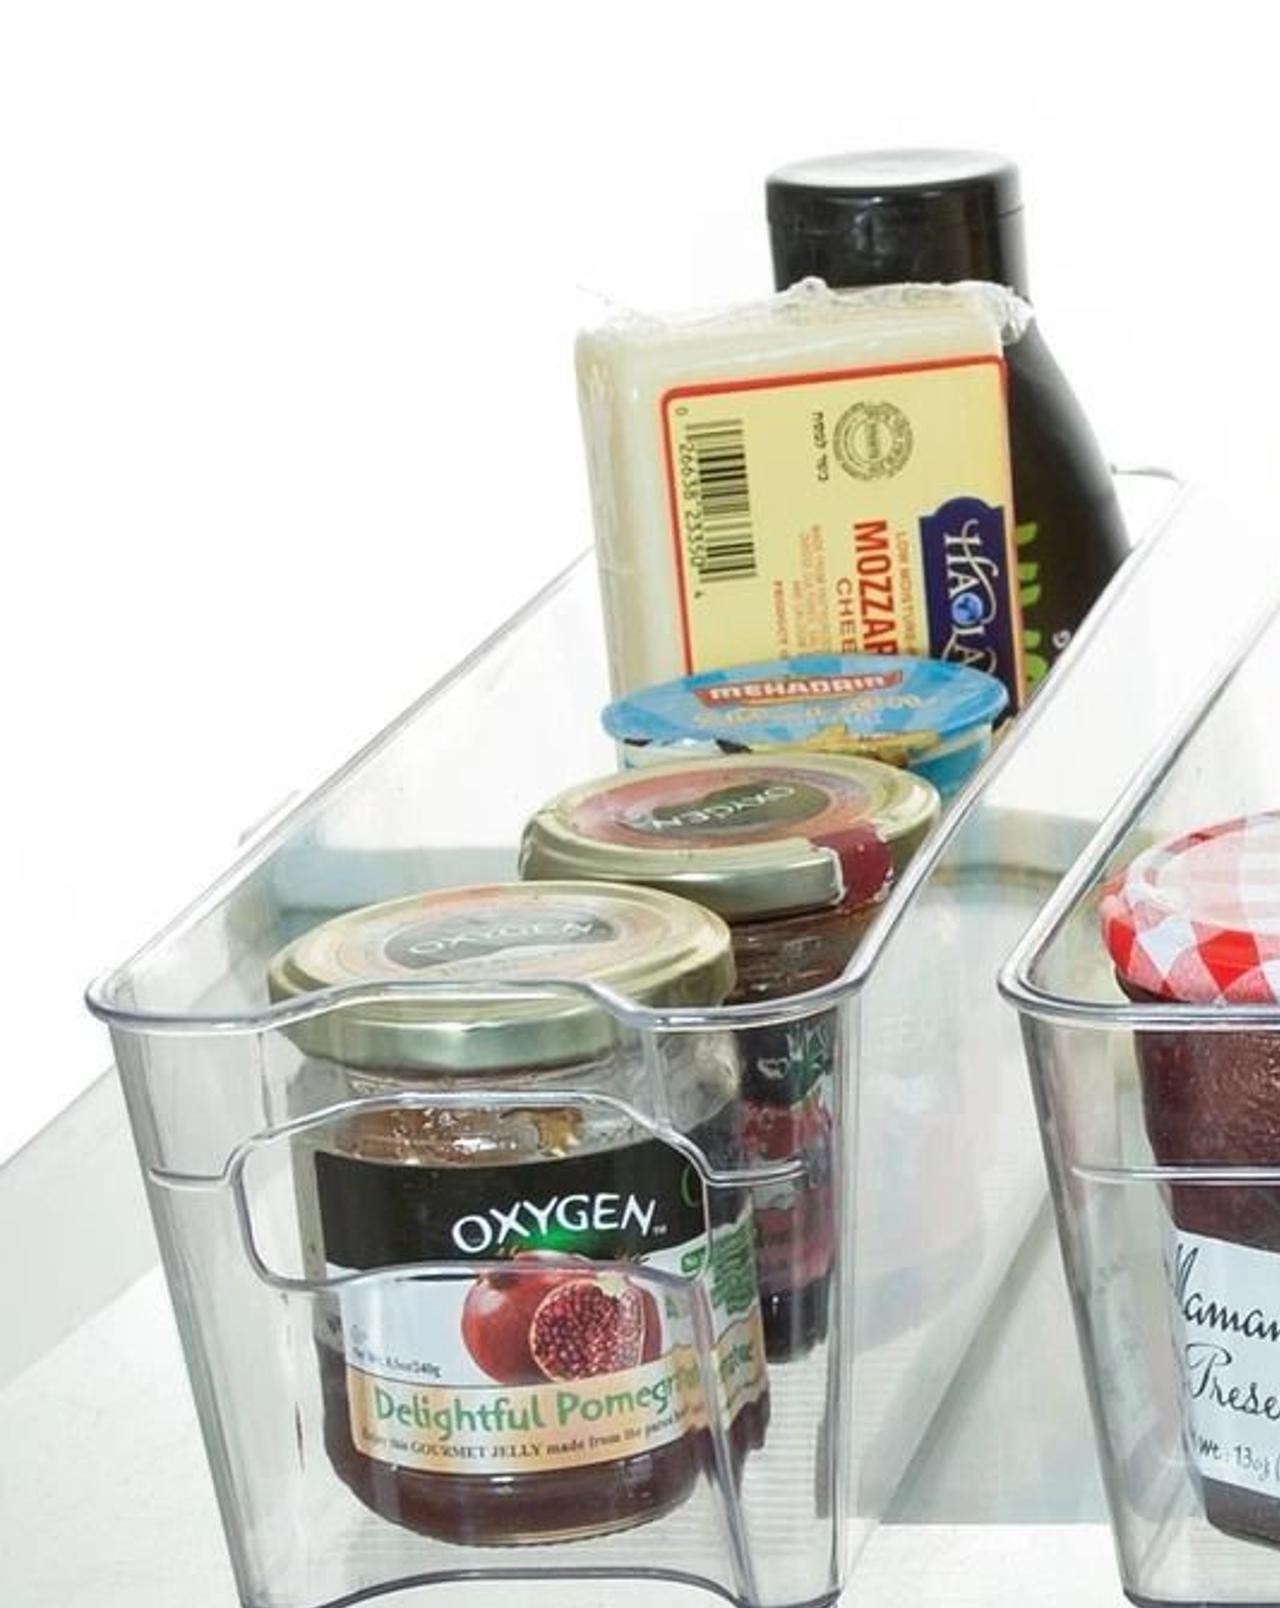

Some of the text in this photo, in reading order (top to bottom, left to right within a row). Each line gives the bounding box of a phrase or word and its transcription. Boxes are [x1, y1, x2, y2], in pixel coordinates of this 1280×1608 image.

[836, 577, 858, 655] CHEE
[852, 519, 898, 656] MOZZAR
[451, 1192, 656, 1254] OXYGEN
[374, 1384, 546, 1442] Delightful
[411, 1440, 486, 1458] GOURMET
[490, 1444, 541, 1459] JELLY
